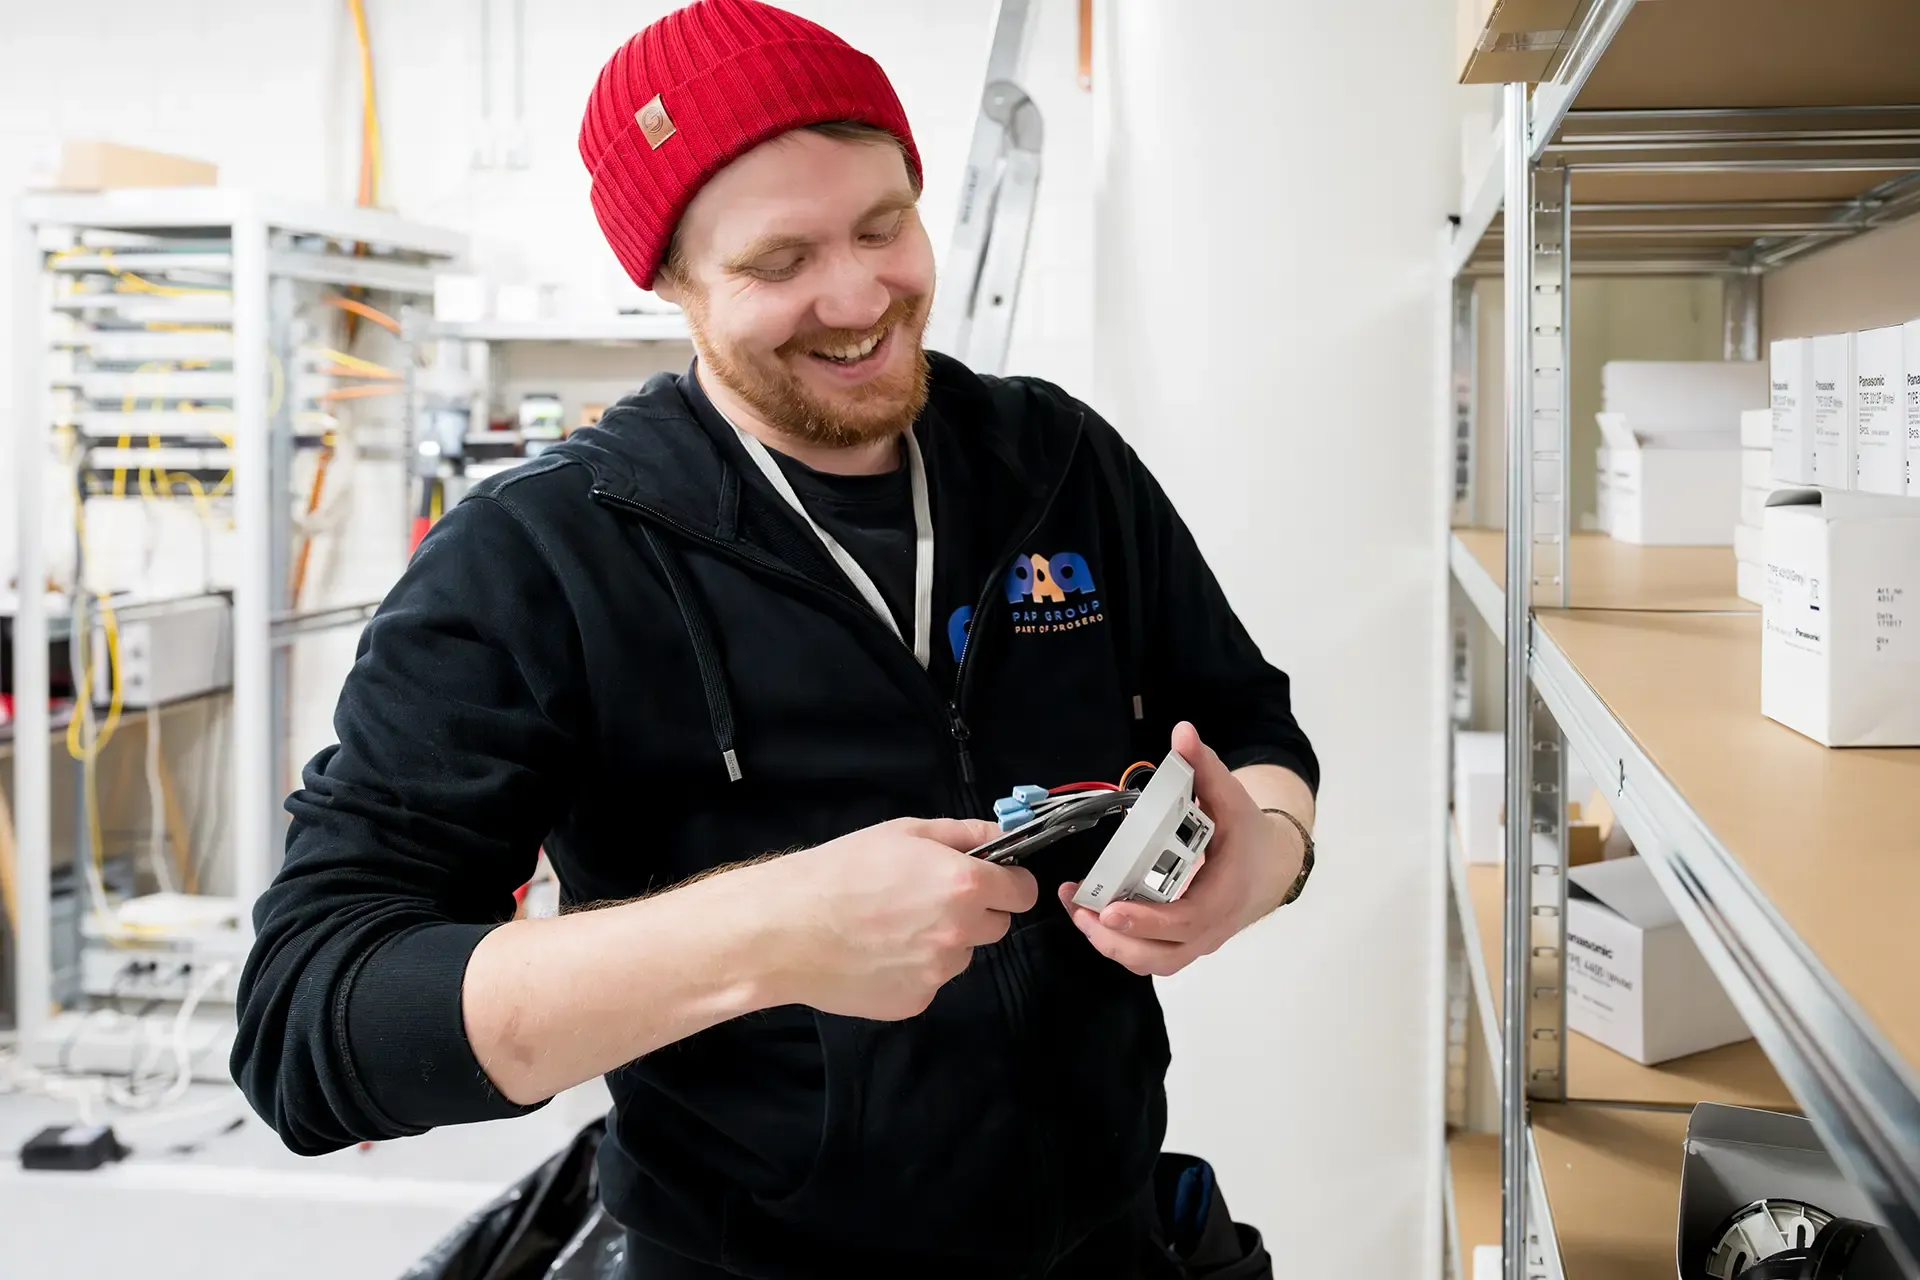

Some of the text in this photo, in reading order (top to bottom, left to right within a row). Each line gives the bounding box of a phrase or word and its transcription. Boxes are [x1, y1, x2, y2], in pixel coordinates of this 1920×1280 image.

[1815, 380, 1836, 391] Panasonic
[1859, 374, 1886, 387] Panasonic
[1011, 599, 1100, 622] PAP GROUP
[1014, 613, 1104, 634] PART OF PROSERO
[1795, 627, 1821, 643] Panasonic
[1566, 932, 1614, 960] anasonic
